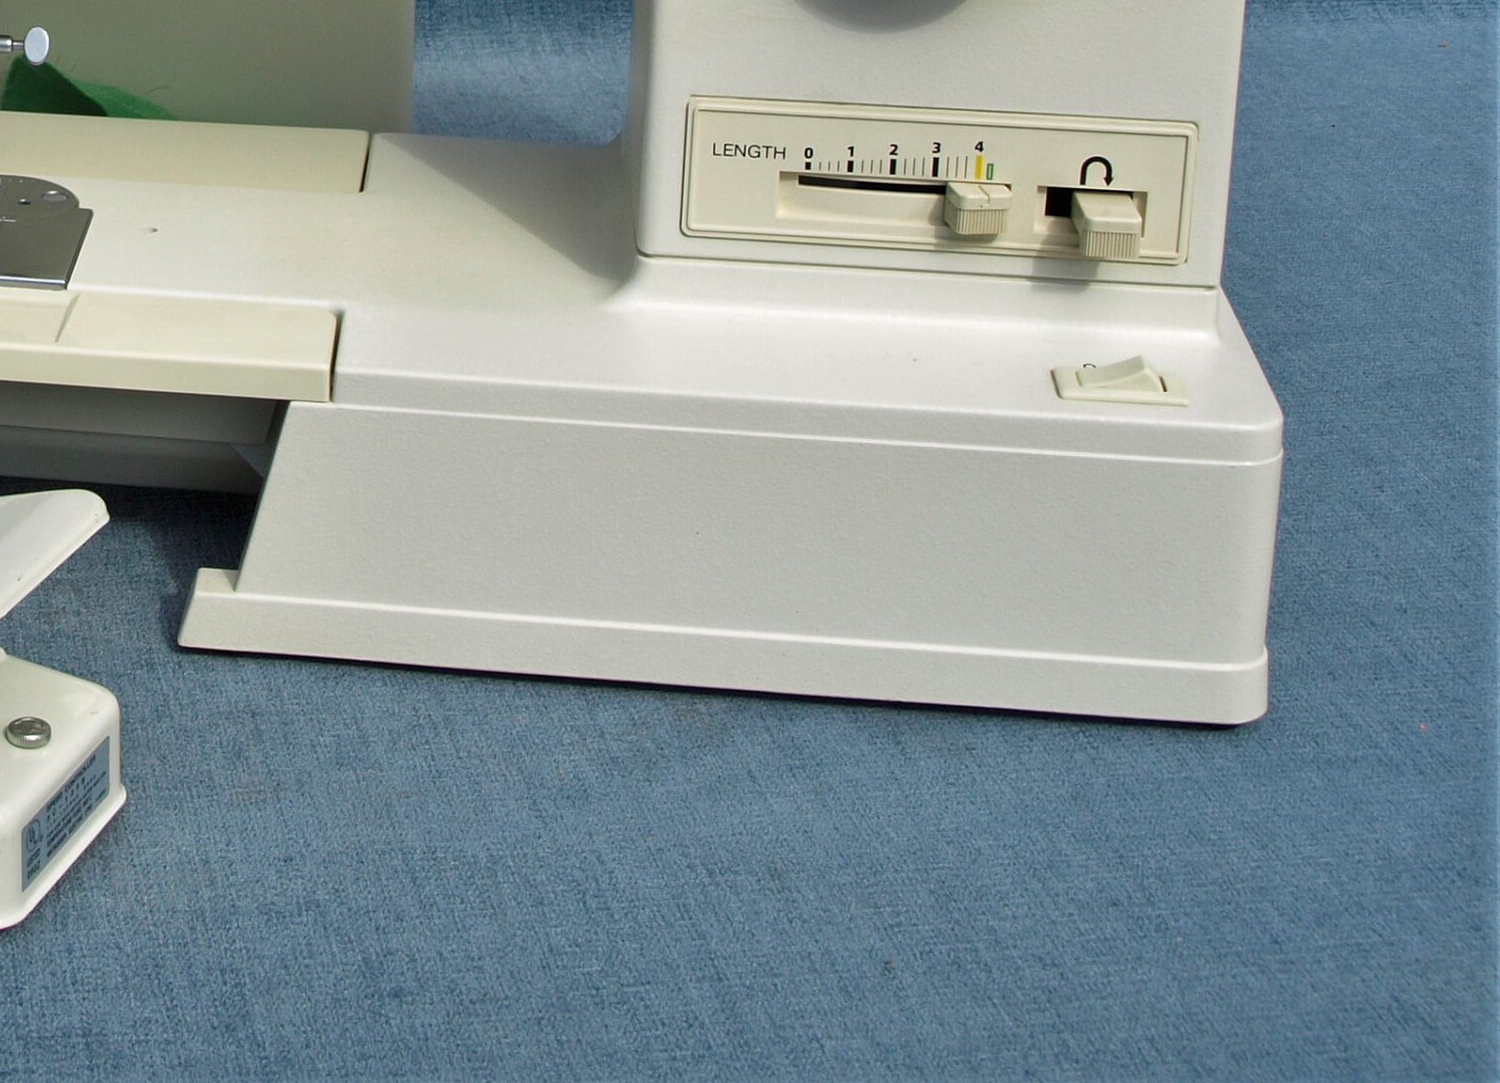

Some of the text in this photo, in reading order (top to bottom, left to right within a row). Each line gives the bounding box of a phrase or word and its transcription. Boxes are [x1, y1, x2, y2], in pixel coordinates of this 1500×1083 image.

[712, 142, 787, 160] LENGTH
[804, 140, 985, 159] 0 1 2 3 4
